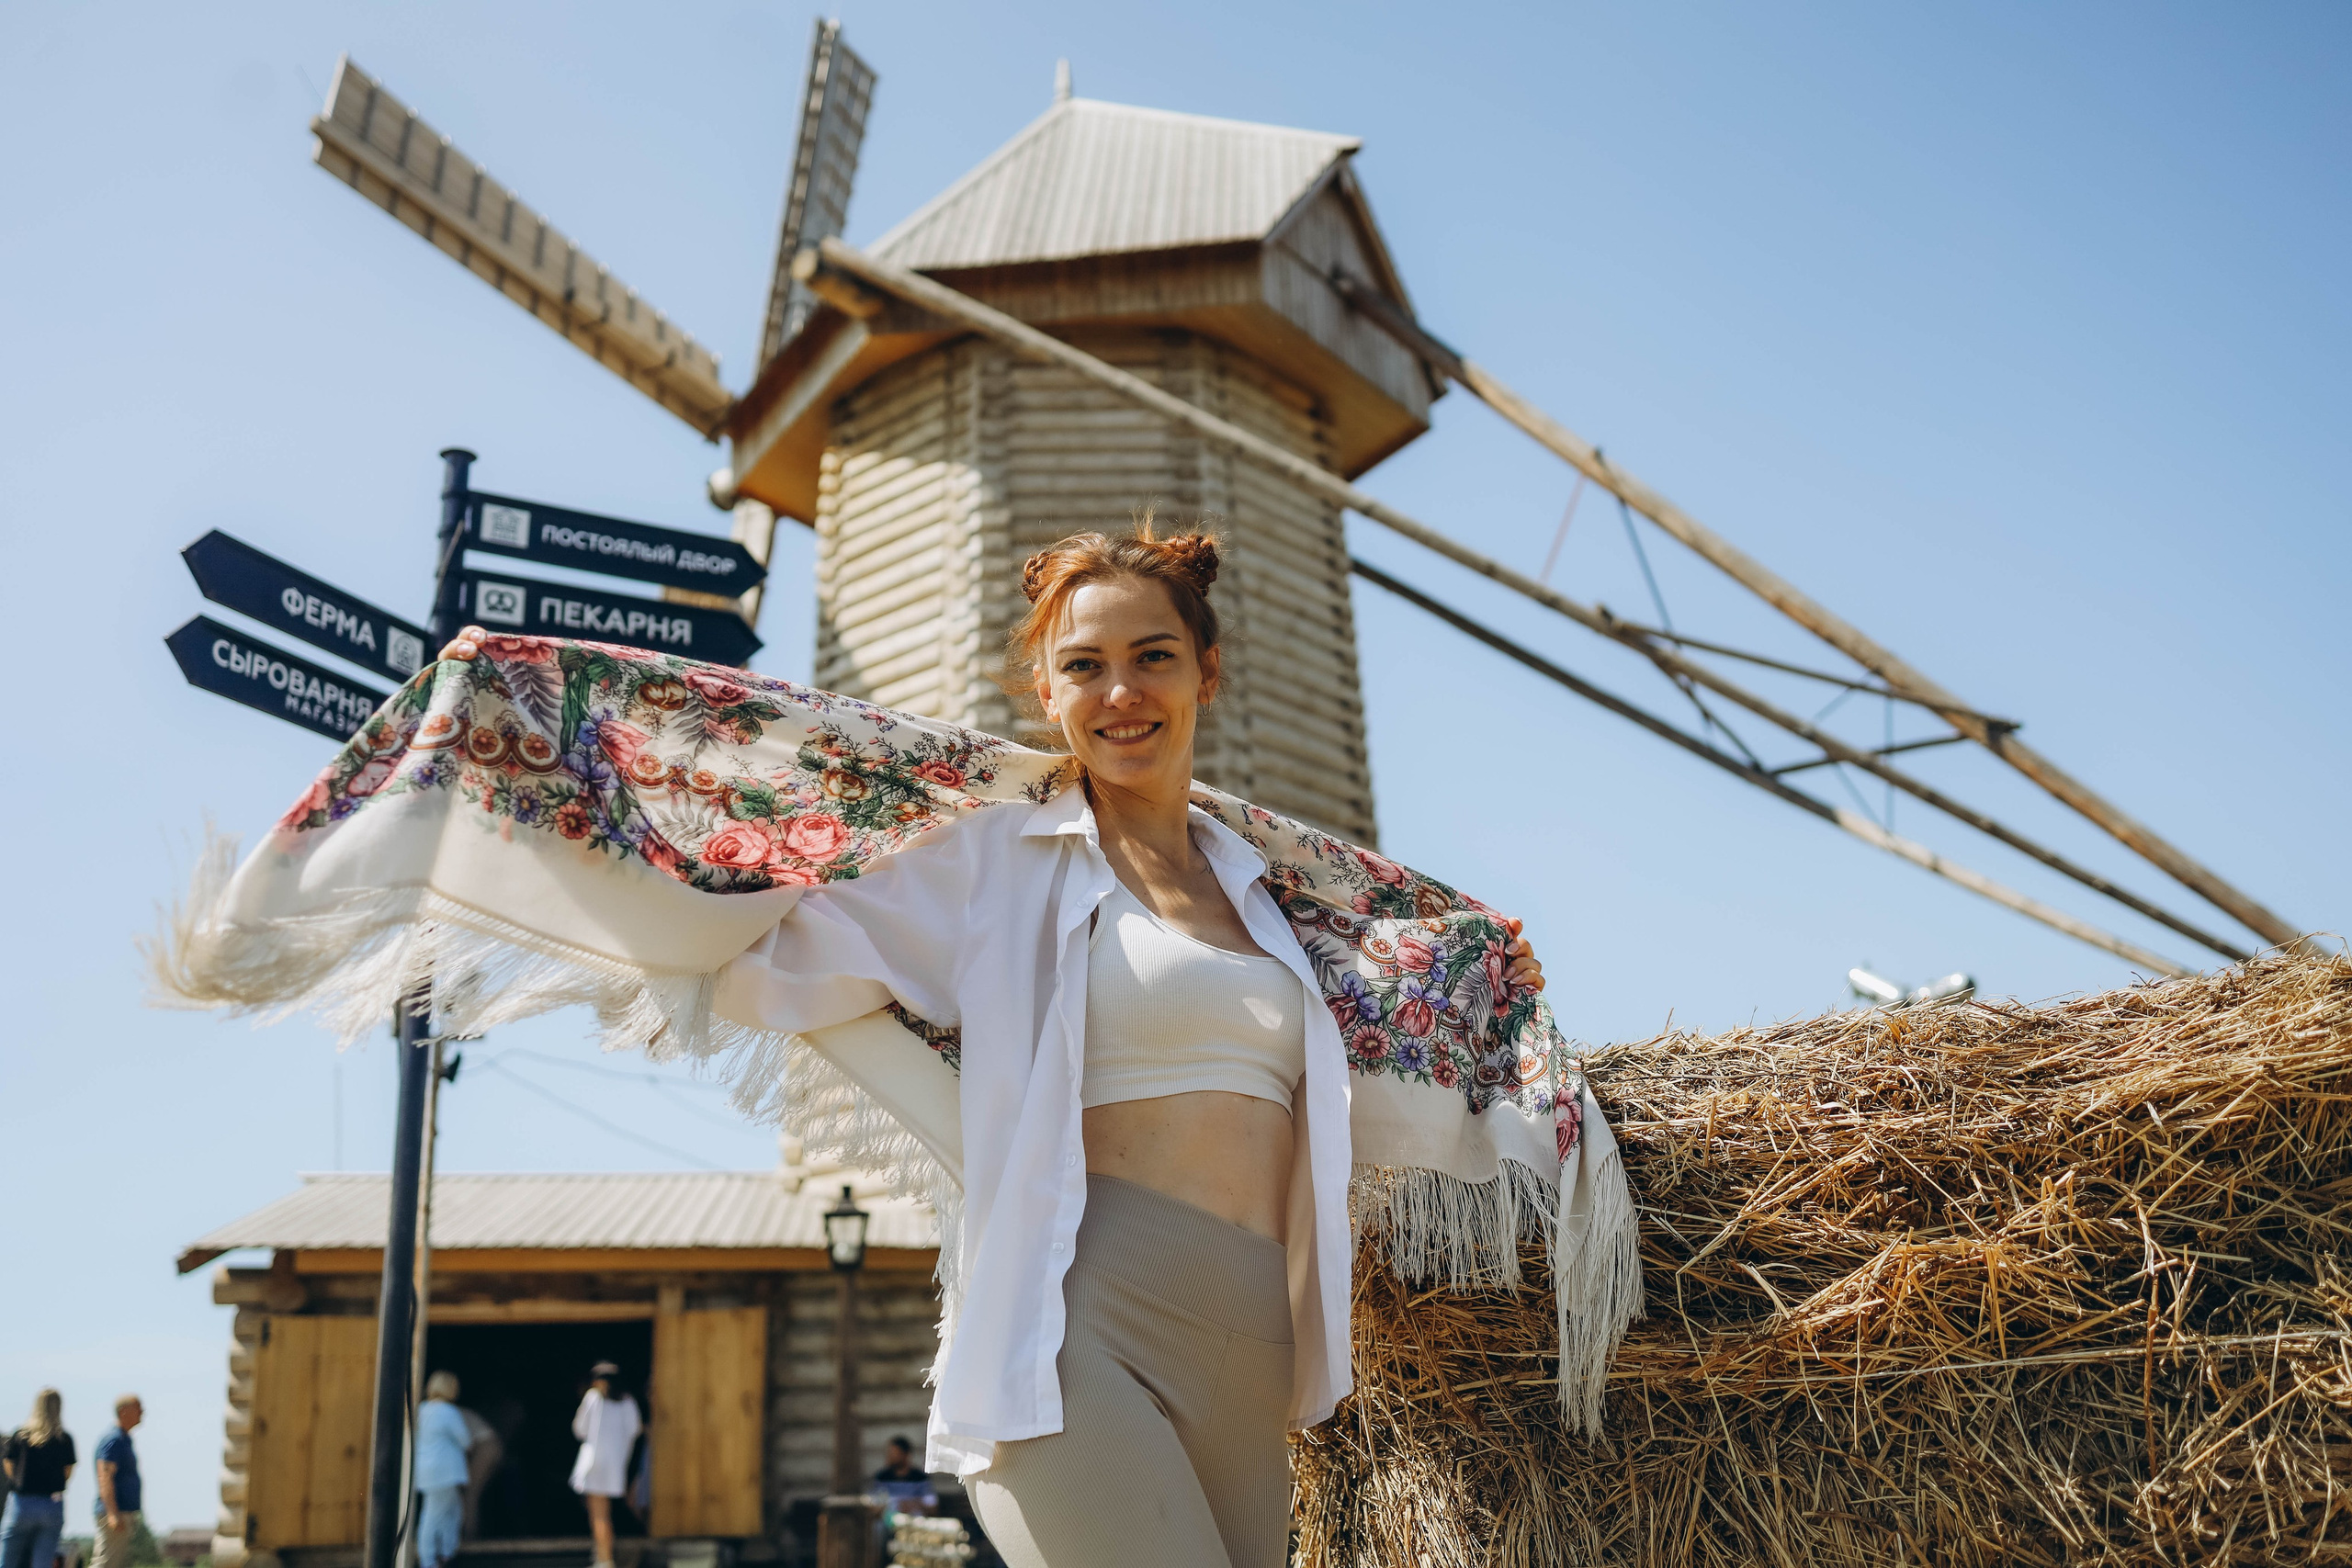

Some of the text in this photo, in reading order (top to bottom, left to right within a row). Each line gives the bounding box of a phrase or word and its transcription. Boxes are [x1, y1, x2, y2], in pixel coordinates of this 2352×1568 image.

[541, 524, 738, 576] ПОСТОЯЛЫЙ ДВОР
[281, 586, 378, 652] ФЕРМА
[539, 596, 693, 647] ПЕКАРНЯ
[212, 638, 373, 721] СЫРОВАРНЯ
[284, 694, 360, 735] МАГАЗИ
